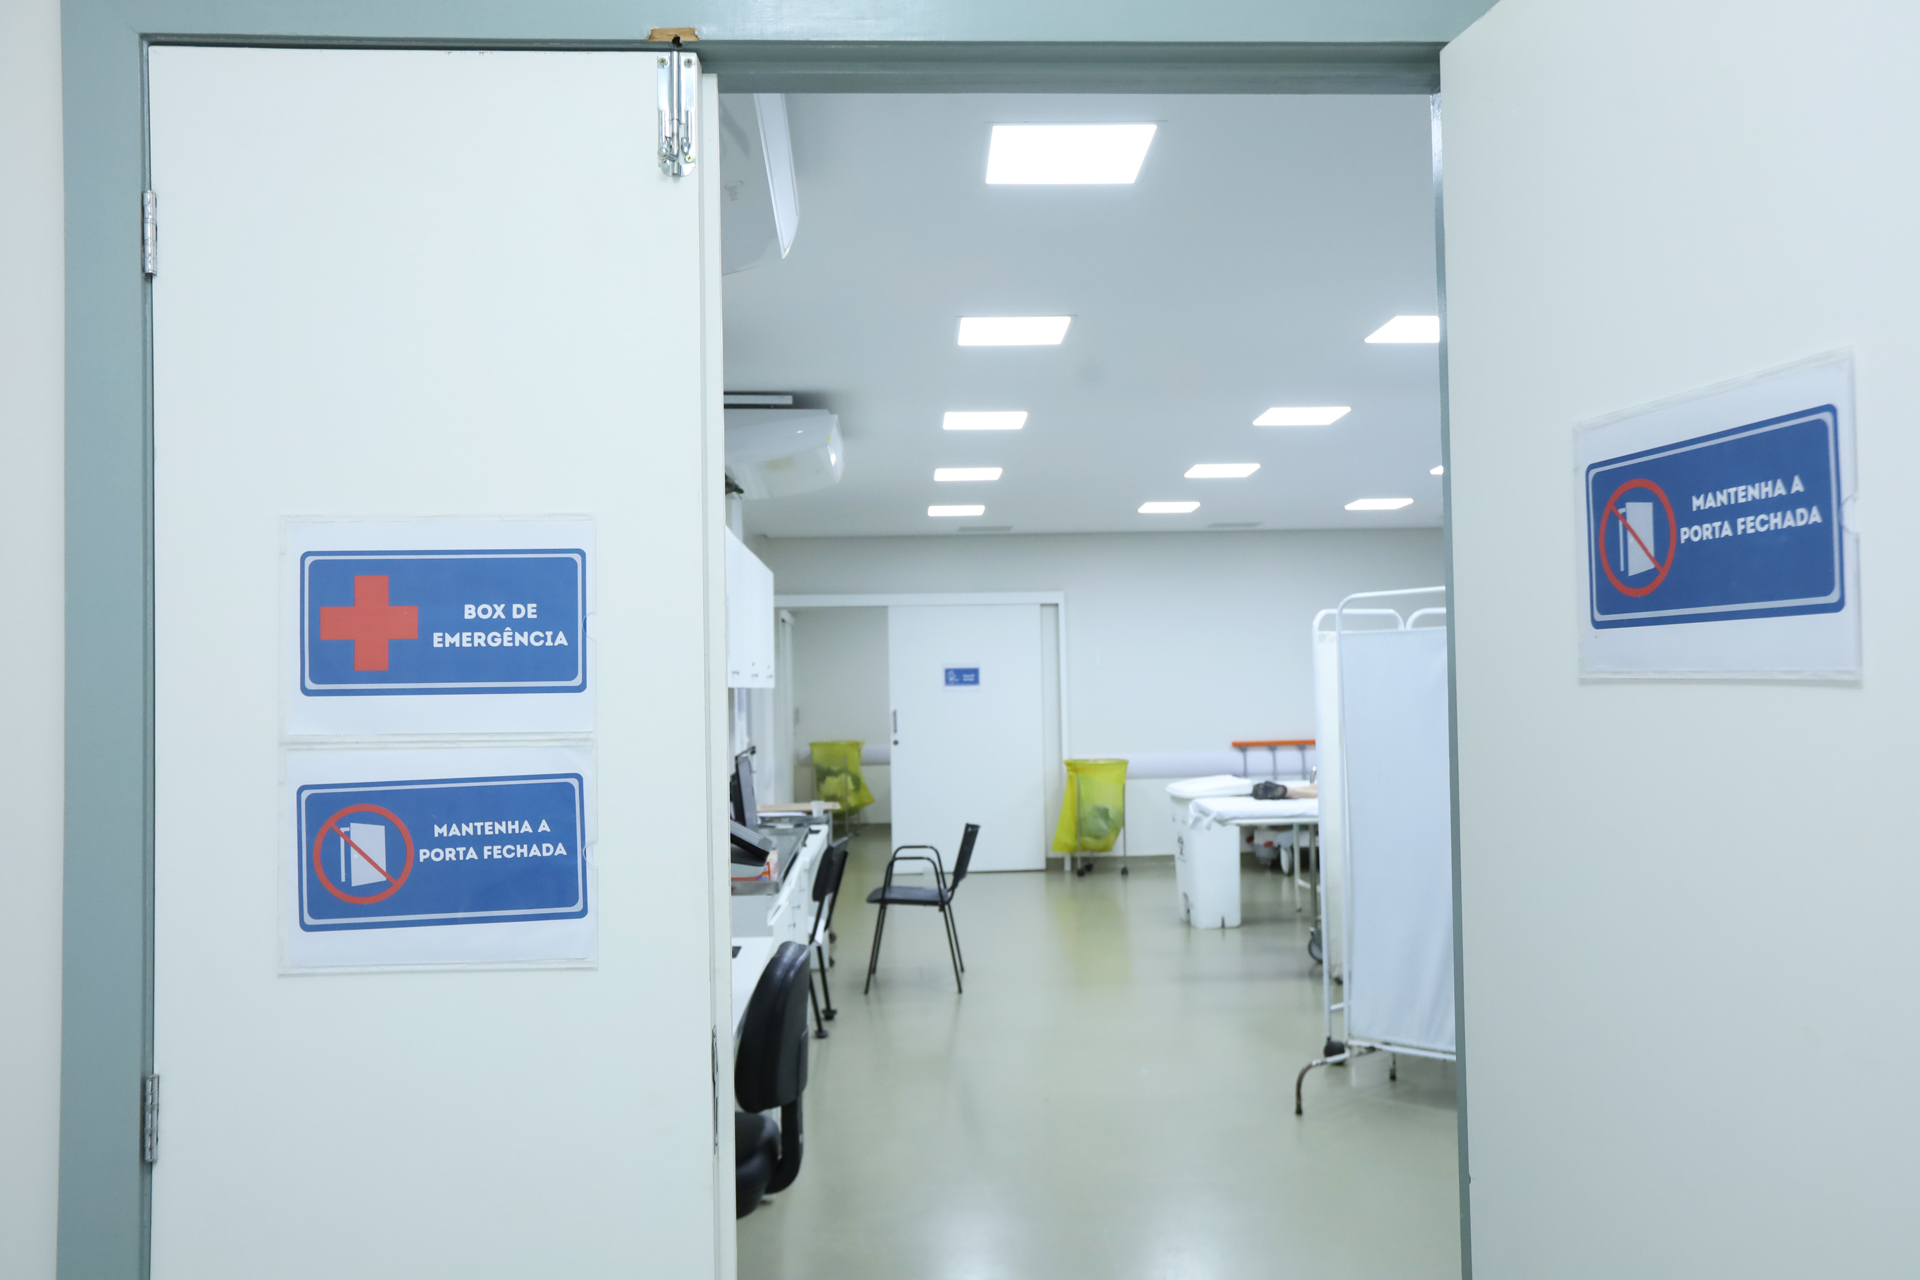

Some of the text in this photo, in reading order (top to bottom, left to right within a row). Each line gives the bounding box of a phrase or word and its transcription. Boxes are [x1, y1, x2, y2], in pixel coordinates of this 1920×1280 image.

[1691, 474, 1805, 511] MANTENHA A
[1681, 505, 1822, 543] PORTA FECHADA
[464, 604, 537, 619] BOX DE
[433, 627, 568, 647] EMERGÊNCIA
[434, 819, 550, 837] MANTENHA A
[420, 843, 567, 862] PORTA FECHADA
